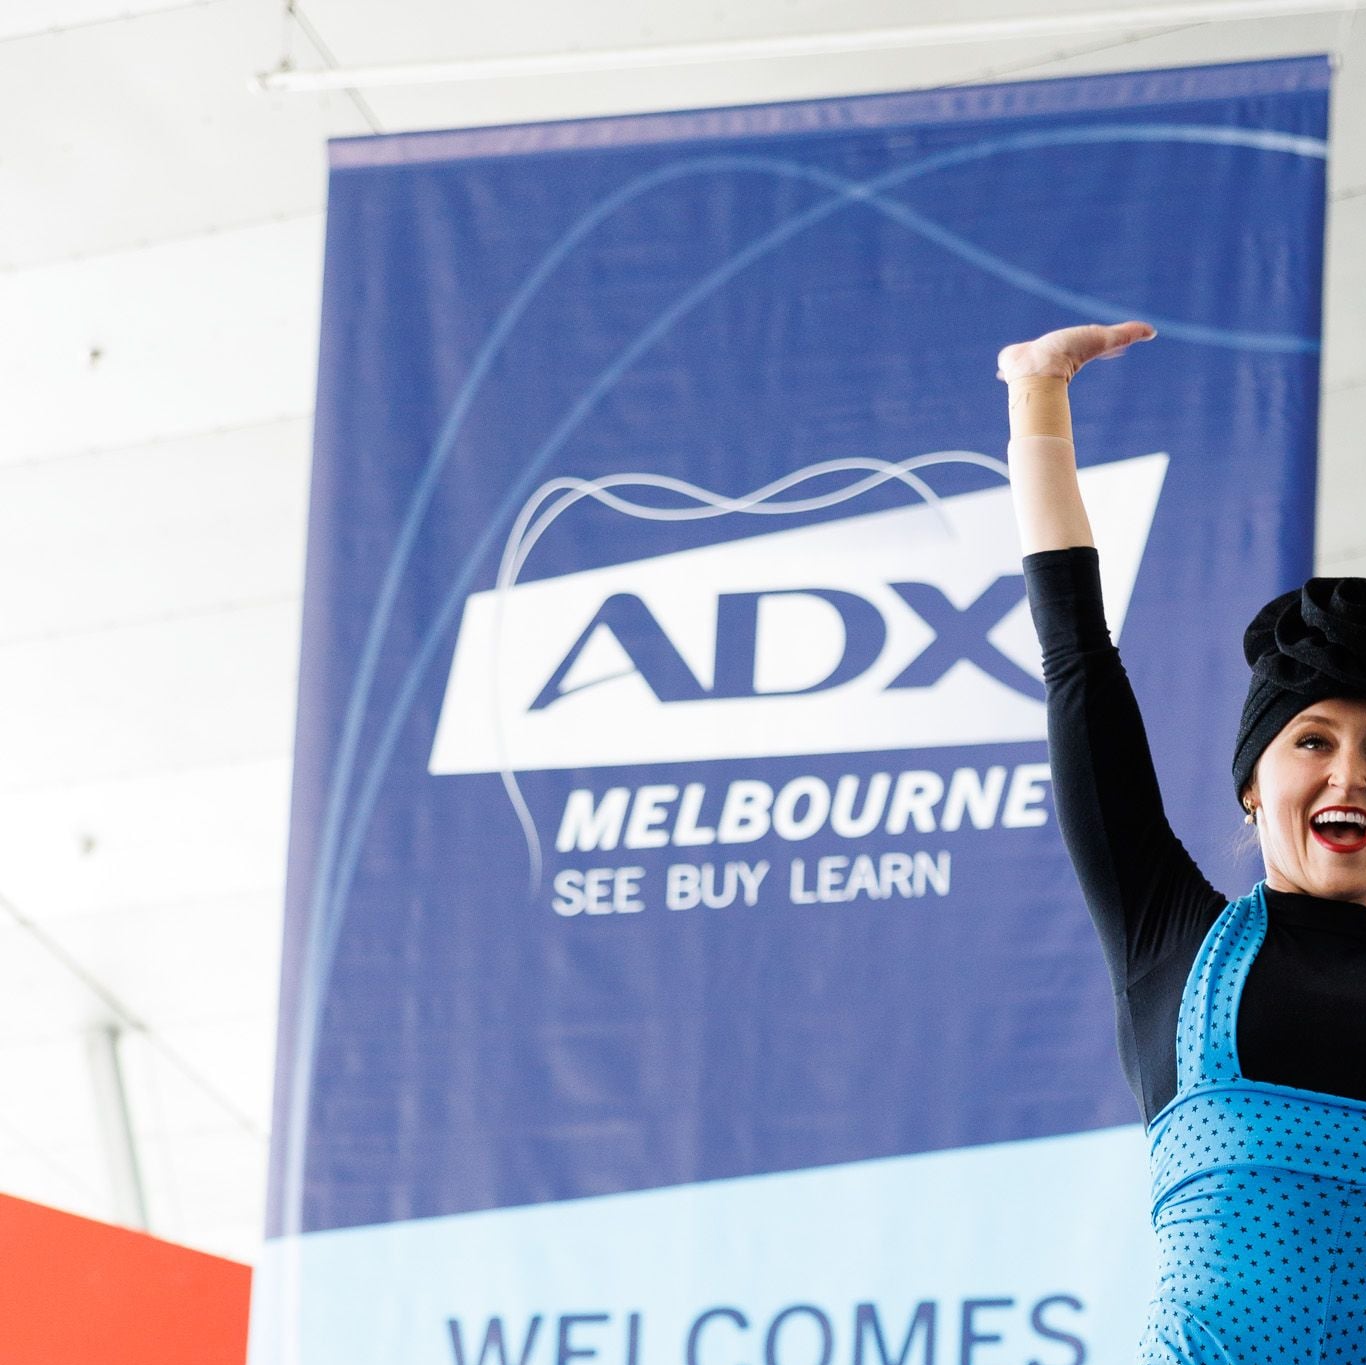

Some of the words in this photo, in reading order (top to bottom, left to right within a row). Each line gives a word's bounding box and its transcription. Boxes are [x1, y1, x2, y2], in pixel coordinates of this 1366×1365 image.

[526, 574, 1048, 712] ADX
[556, 762, 1052, 852] MELBOURNE
[552, 865, 646, 917] SEE
[665, 858, 771, 911] BUY
[790, 851, 951, 904] LEARN
